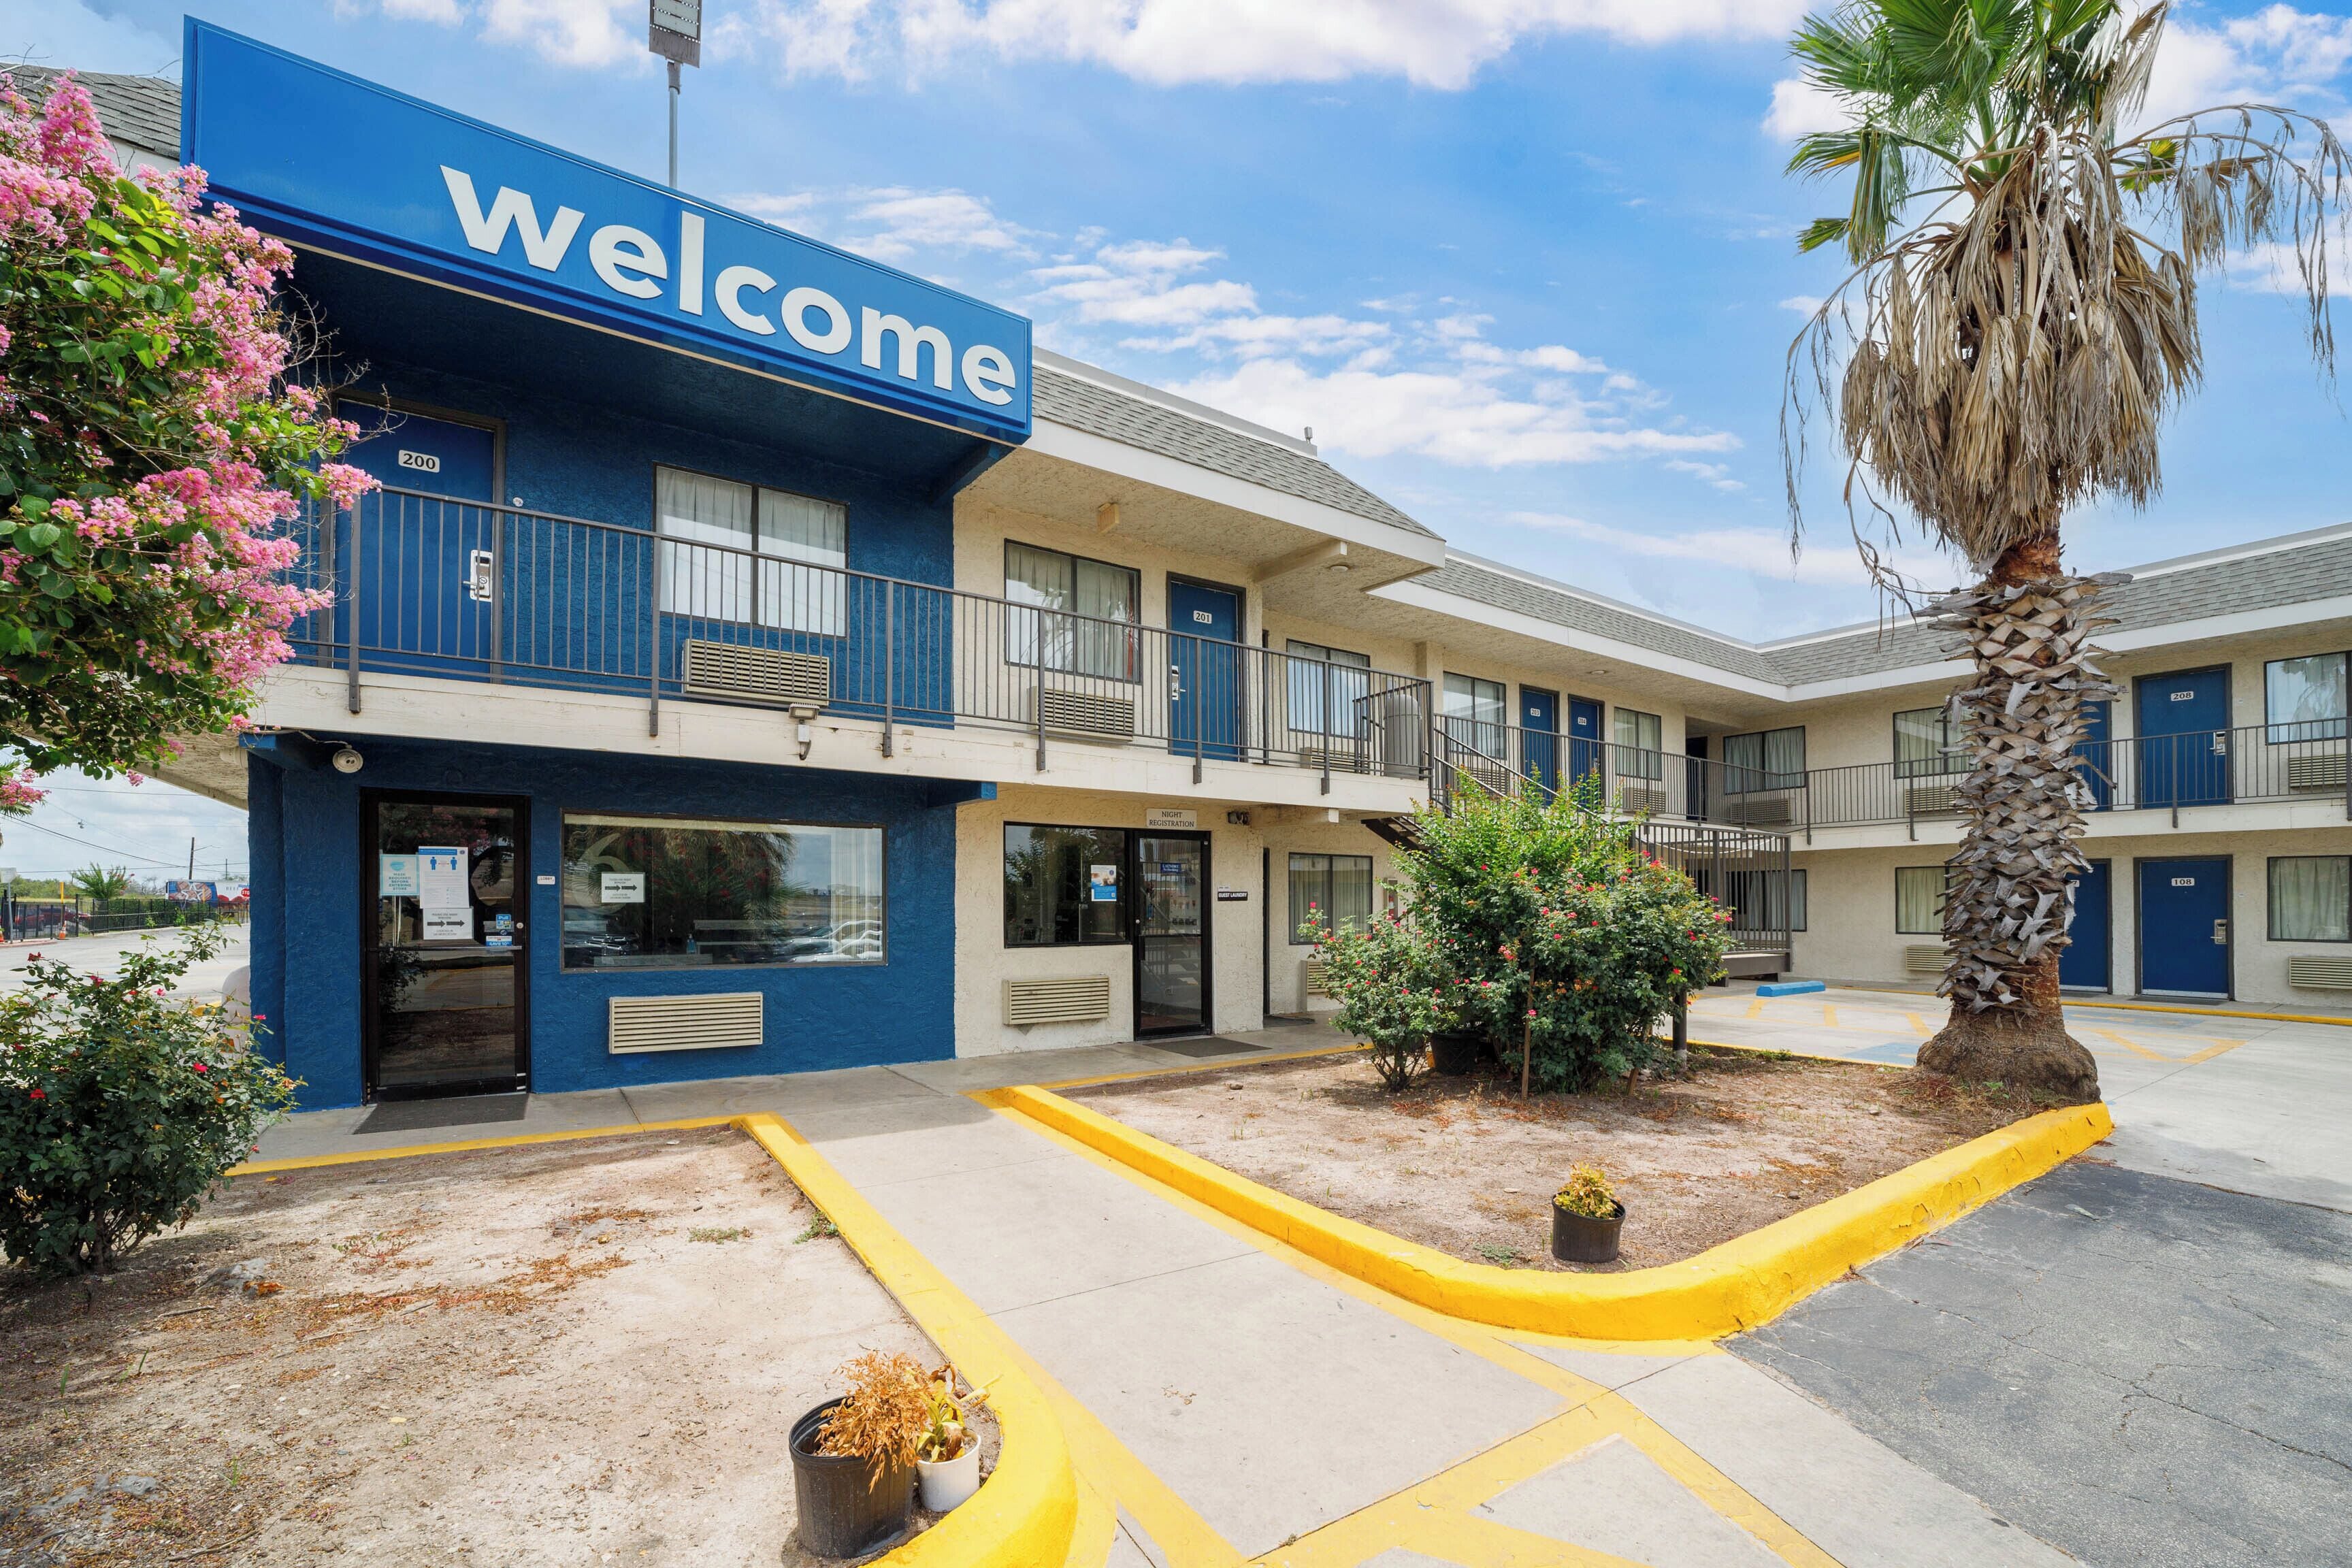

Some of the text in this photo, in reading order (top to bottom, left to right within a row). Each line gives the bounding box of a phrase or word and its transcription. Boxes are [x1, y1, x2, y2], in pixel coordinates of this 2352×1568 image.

[440, 164, 1016, 406] welcome
[402, 453, 436, 470] 200
[1196, 612, 1209, 622] 201
[1149, 819, 1194, 827] REGISTRATION
